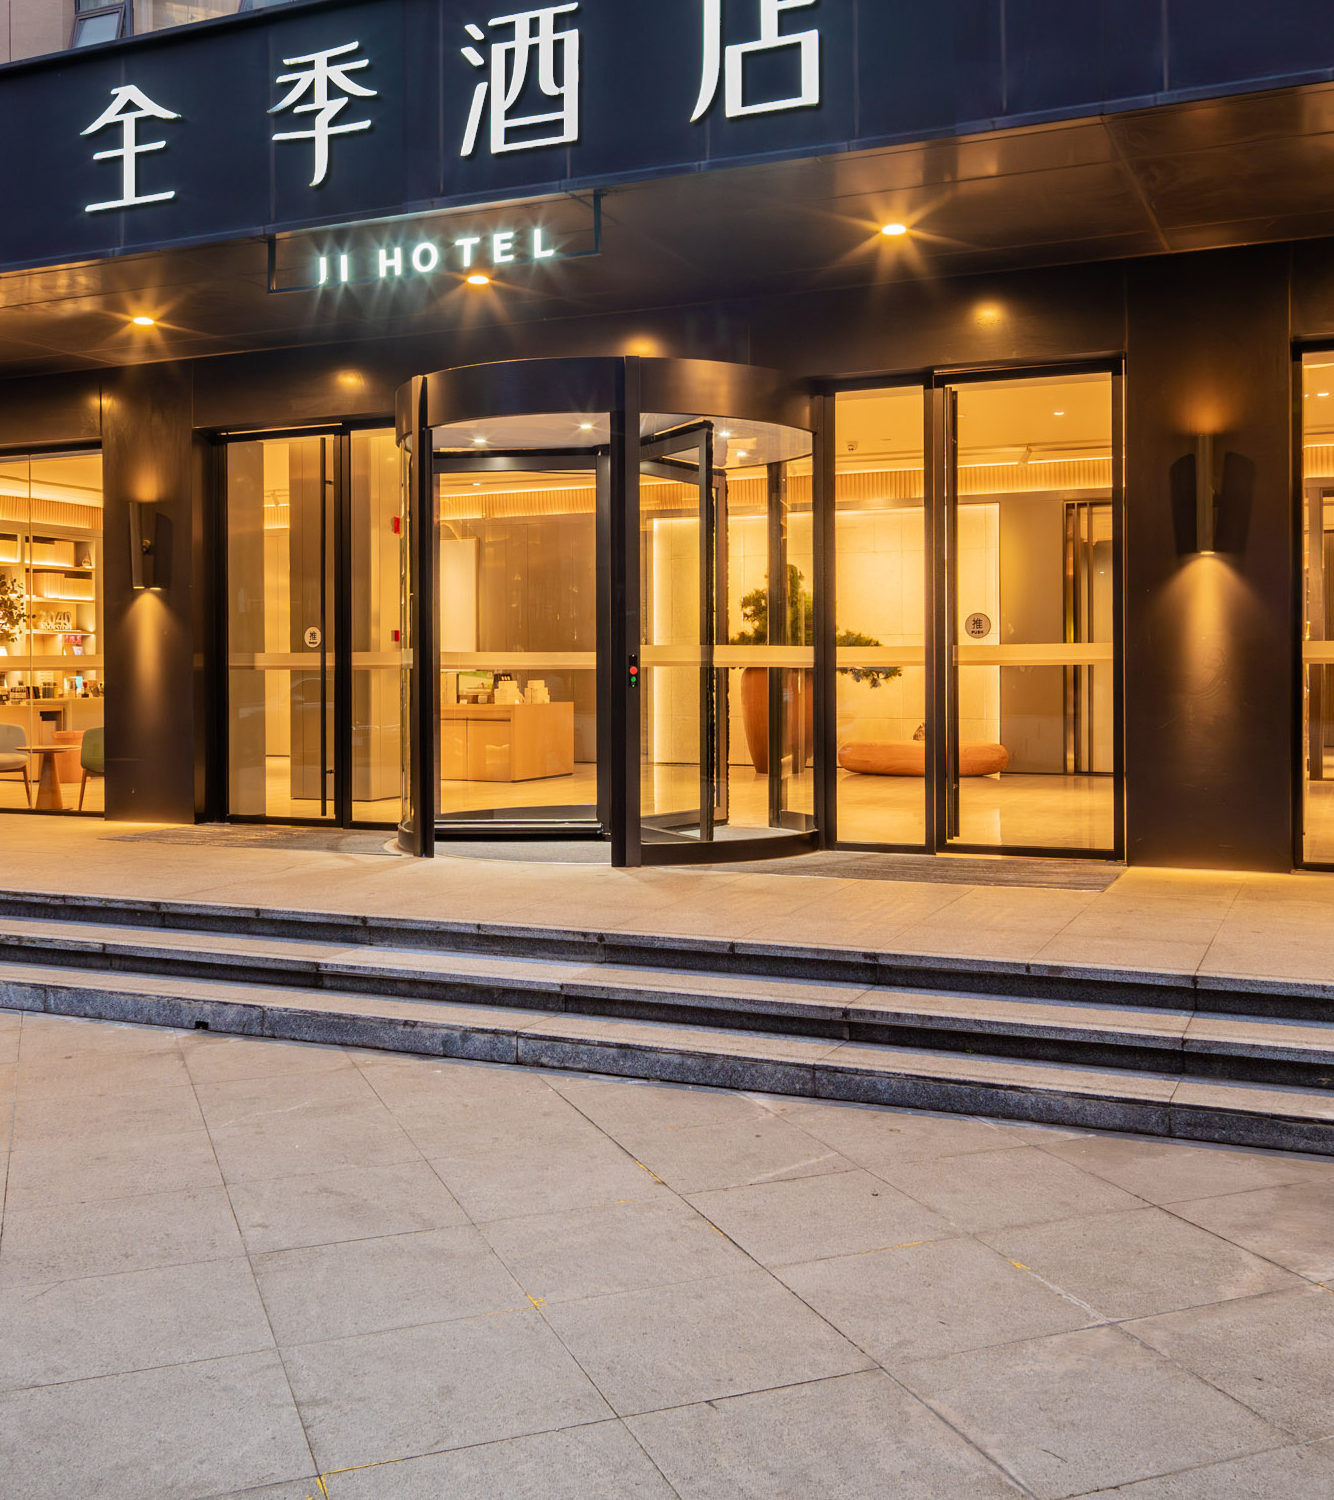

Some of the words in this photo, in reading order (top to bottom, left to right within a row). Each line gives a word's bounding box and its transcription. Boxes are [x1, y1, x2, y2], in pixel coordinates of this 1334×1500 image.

[318, 255, 348, 285] JI
[379, 228, 555, 279] HOTEL
[971, 617, 983, 630] 推
